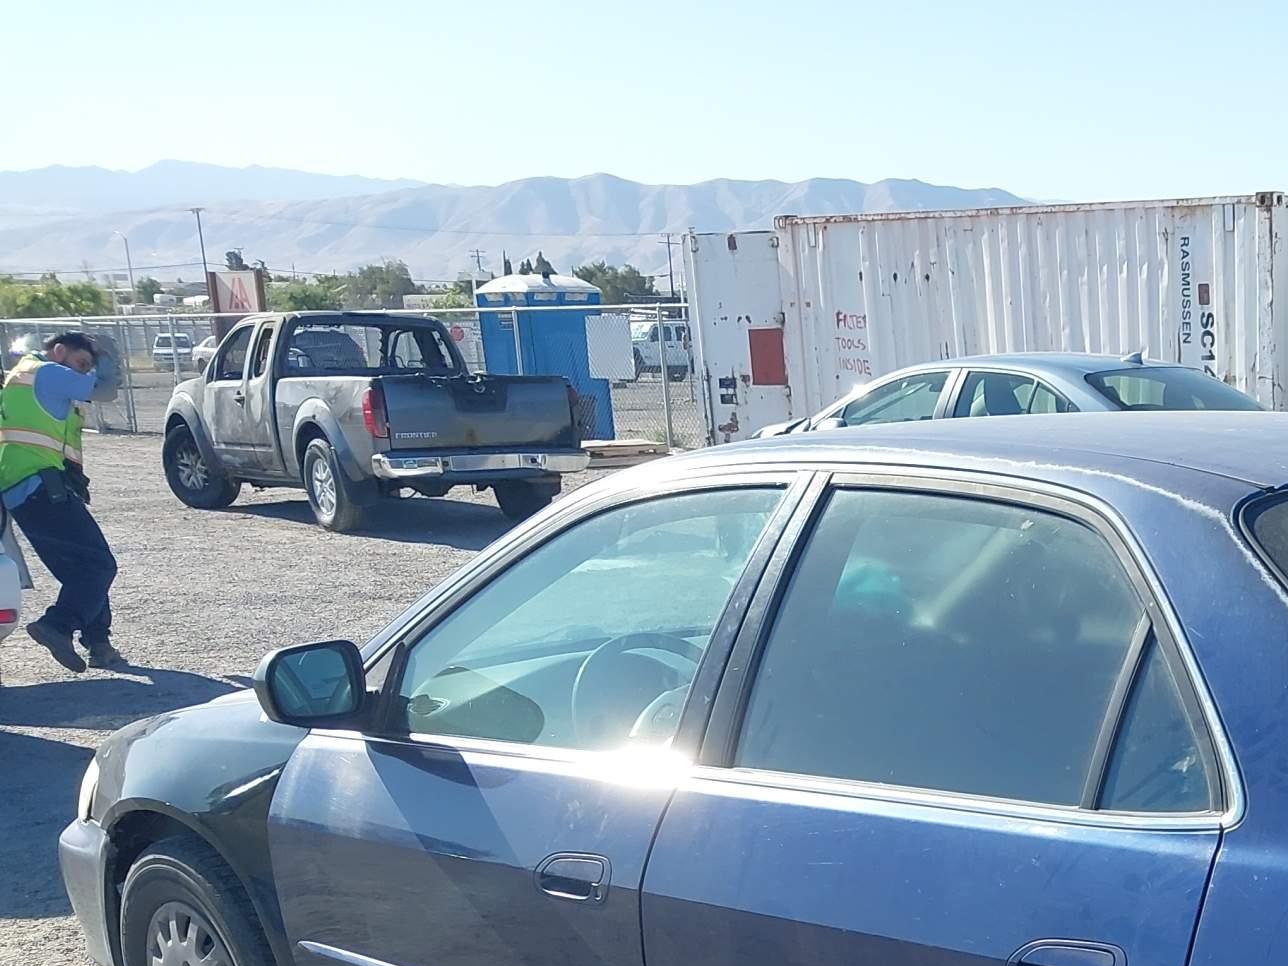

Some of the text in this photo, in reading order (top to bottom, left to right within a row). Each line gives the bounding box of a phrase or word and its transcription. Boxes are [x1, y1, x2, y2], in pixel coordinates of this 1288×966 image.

[1180, 236, 1192, 344] RASMUSSEN
[834, 337, 867, 352] TOOLS
[838, 357, 872, 376] INSIDE
